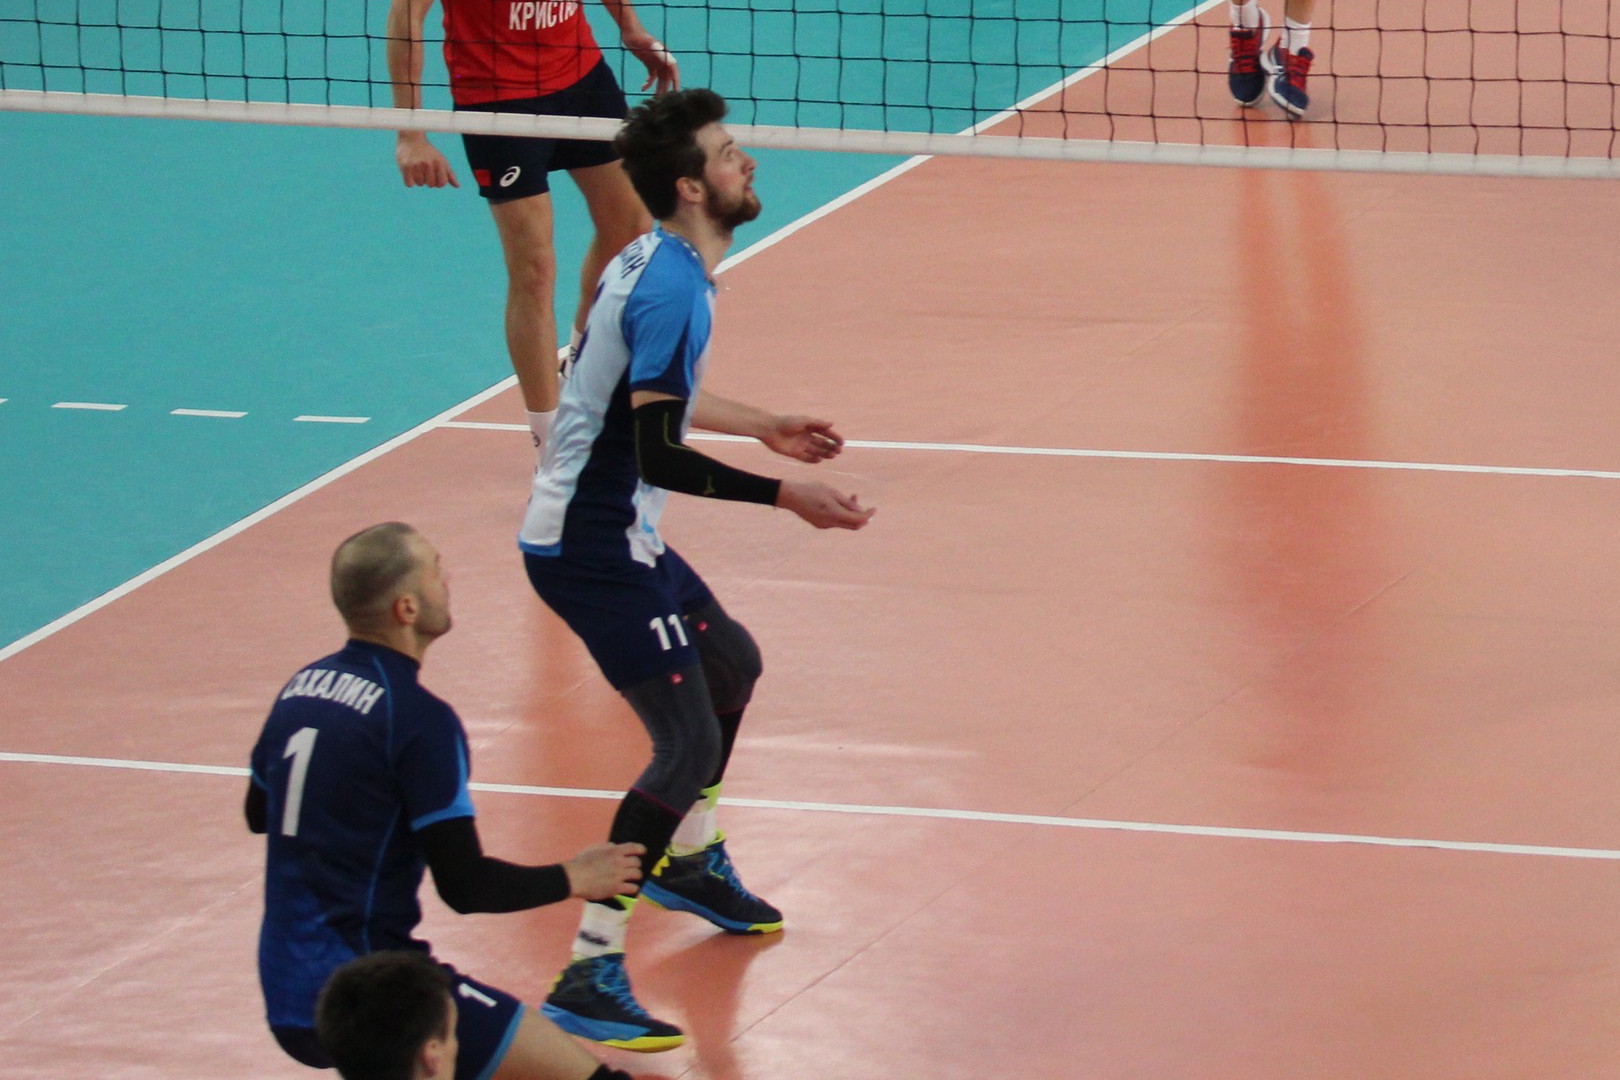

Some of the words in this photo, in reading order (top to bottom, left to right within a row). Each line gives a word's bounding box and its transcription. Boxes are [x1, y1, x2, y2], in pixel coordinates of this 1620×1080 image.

[650, 614, 689, 651] 11
[280, 726, 319, 837] 1
[458, 982, 498, 1008] 1
